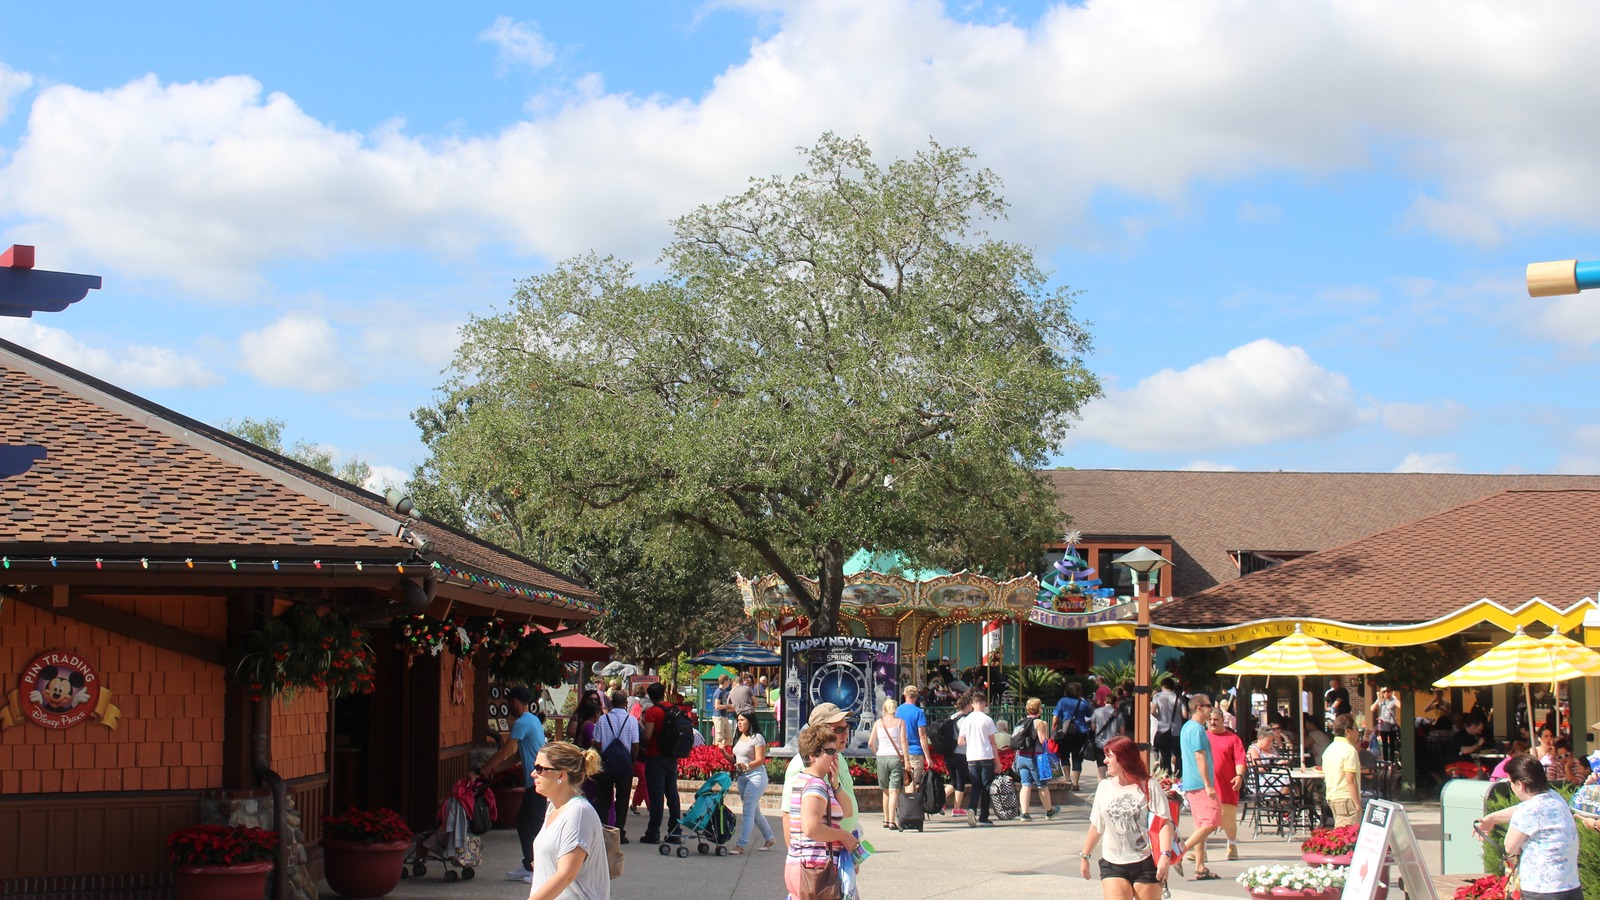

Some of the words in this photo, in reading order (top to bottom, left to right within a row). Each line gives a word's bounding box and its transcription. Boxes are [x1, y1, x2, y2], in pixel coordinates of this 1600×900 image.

[1030, 608, 1117, 628] CHRISTMAS
[1207, 633, 1237, 643] THE
[1252, 622, 1341, 637] ORIGNAL
[790, 637, 827, 652] HAPPY
[829, 636, 856, 646] NEW
[856, 637, 889, 653] YEAR!
[826, 654, 853, 662] SPRINGS
[25, 663, 42, 683] PIN
[43, 654, 95, 682] TRADING
